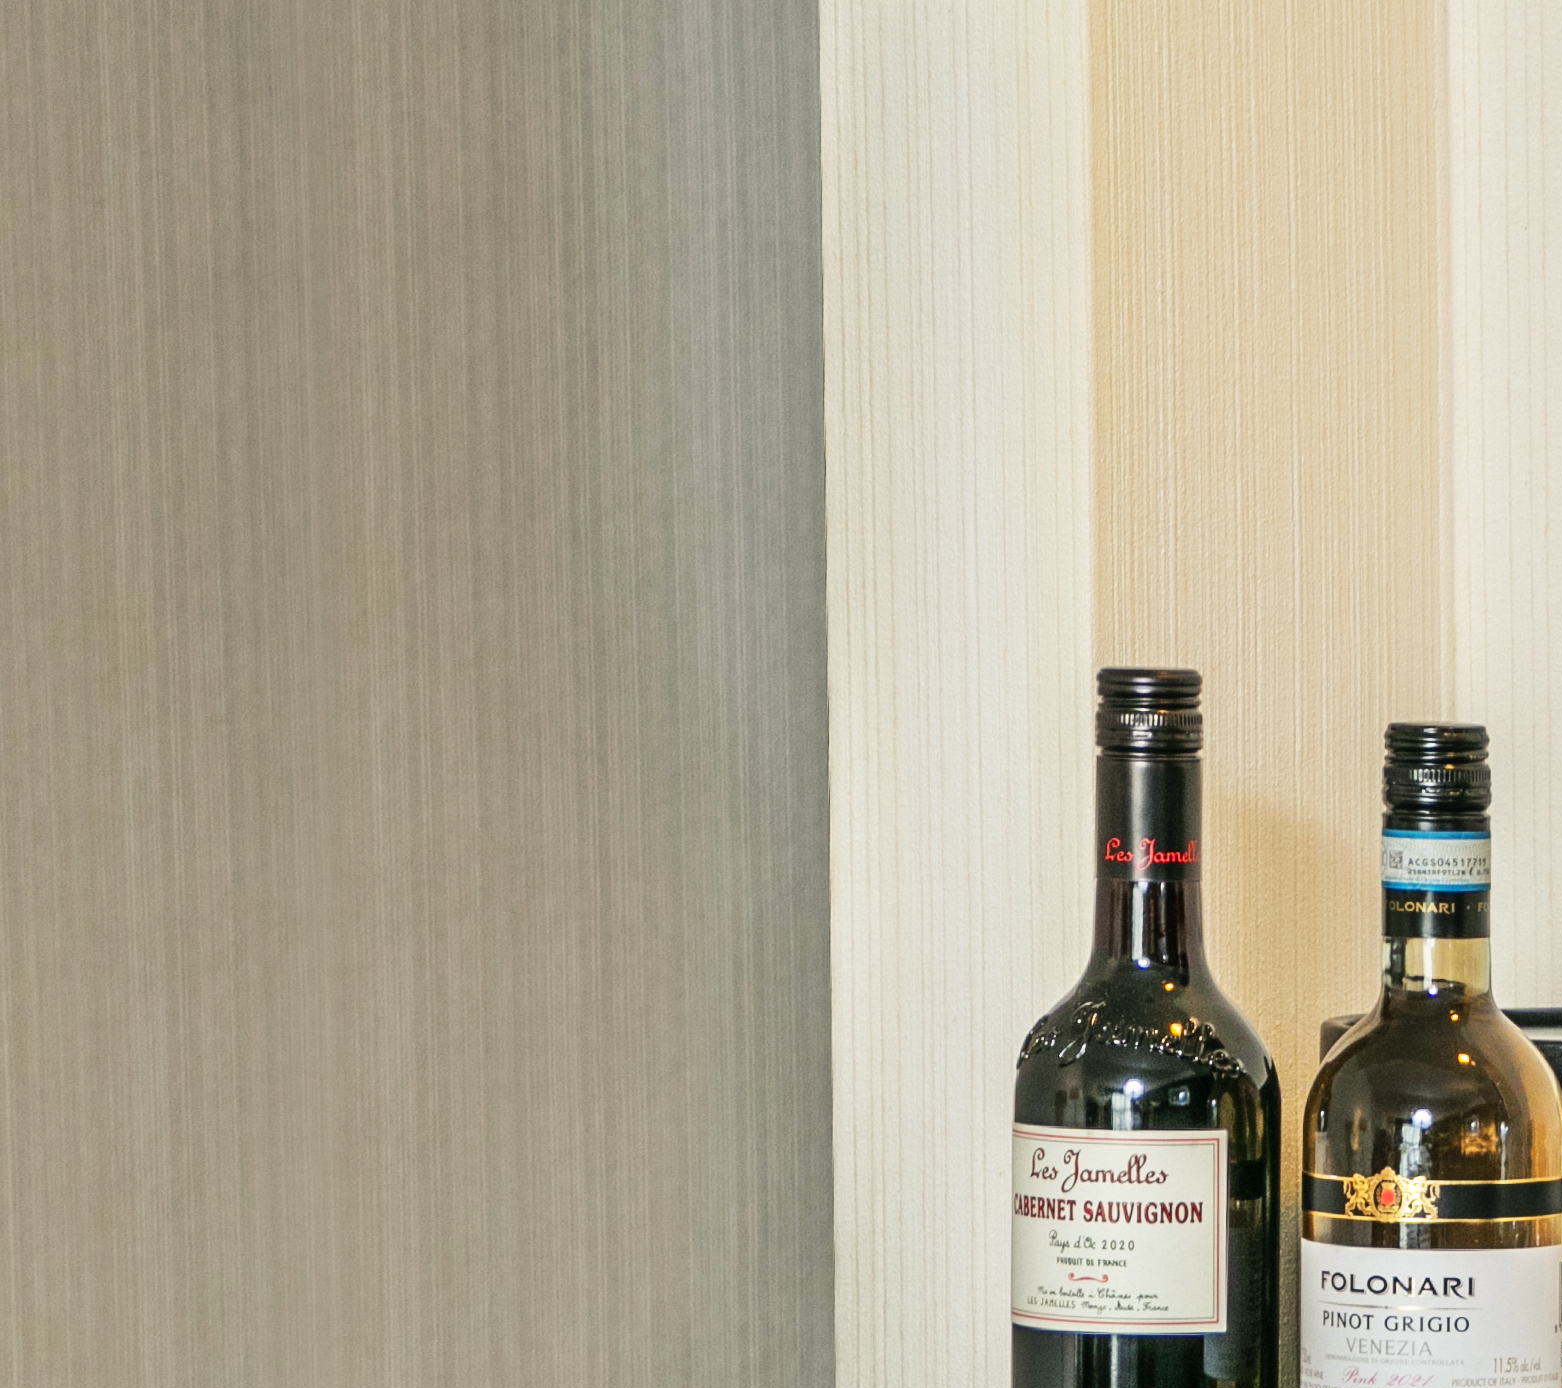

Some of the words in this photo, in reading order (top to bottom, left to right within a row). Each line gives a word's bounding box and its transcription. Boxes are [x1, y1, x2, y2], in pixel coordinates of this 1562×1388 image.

[1104, 837, 1133, 862] Les
[1388, 900, 1456, 915] OLONARI
[1030, 1147, 1059, 1181] Les
[1060, 1149, 1169, 1194] Jamelles
[1013, 1193, 1077, 1222] CABERNET
[1083, 1199, 1204, 1225] SAUVIGNON
[1048, 1229, 1071, 1254] Pays
[1101, 1239, 1136, 1251] 2020
[1056, 1256, 1084, 1267] PRODUIT
[1086, 1258, 1095, 1267] DE
[1097, 1258, 1128, 1268] FRANCE
[1320, 1270, 1477, 1300] FOLONARI
[1027, 1295, 1038, 1305] LES
[1041, 1297, 1076, 1309] JAMELLES
[1322, 1310, 1375, 1330] PINOT
[1384, 1315, 1470, 1333] GRIGIO
[1345, 1337, 1433, 1357] VENEZIA
[1341, 1365, 1380, 1385] Pink
[1385, 1373, 1436, 1387] 2021
[1492, 1357, 1519, 1374] 11.5%
[1451, 1377, 1486, 1388] PRODUCT
[1487, 1377, 1498, 1387] OF
[1499, 1376, 1517, 1386] ITALY
